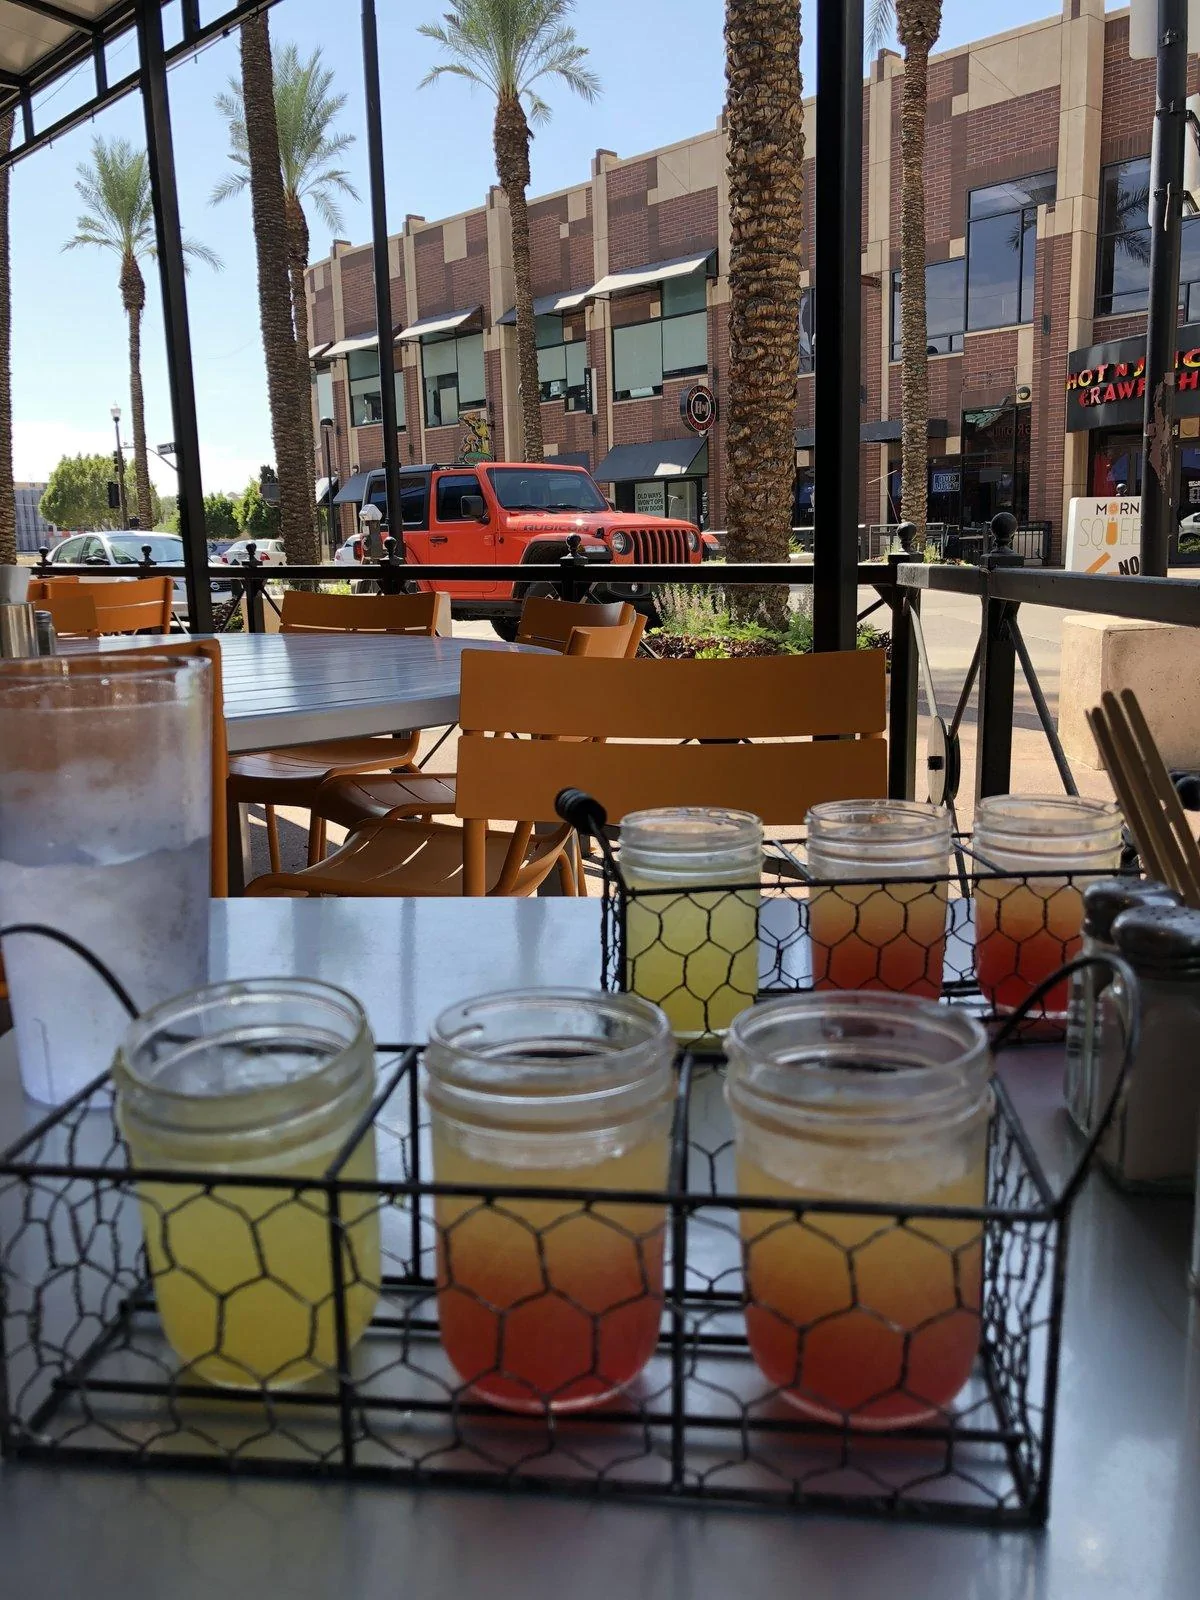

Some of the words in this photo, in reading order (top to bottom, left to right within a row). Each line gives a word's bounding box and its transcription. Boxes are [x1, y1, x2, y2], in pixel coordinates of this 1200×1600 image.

[1066, 364, 1109, 390] HOT
[1133, 347, 1200, 377] JIC
[1078, 370, 1199, 407] CRAWFH
[524, 524, 589, 533] RUBICON
[1118, 555, 1139, 576] NO
